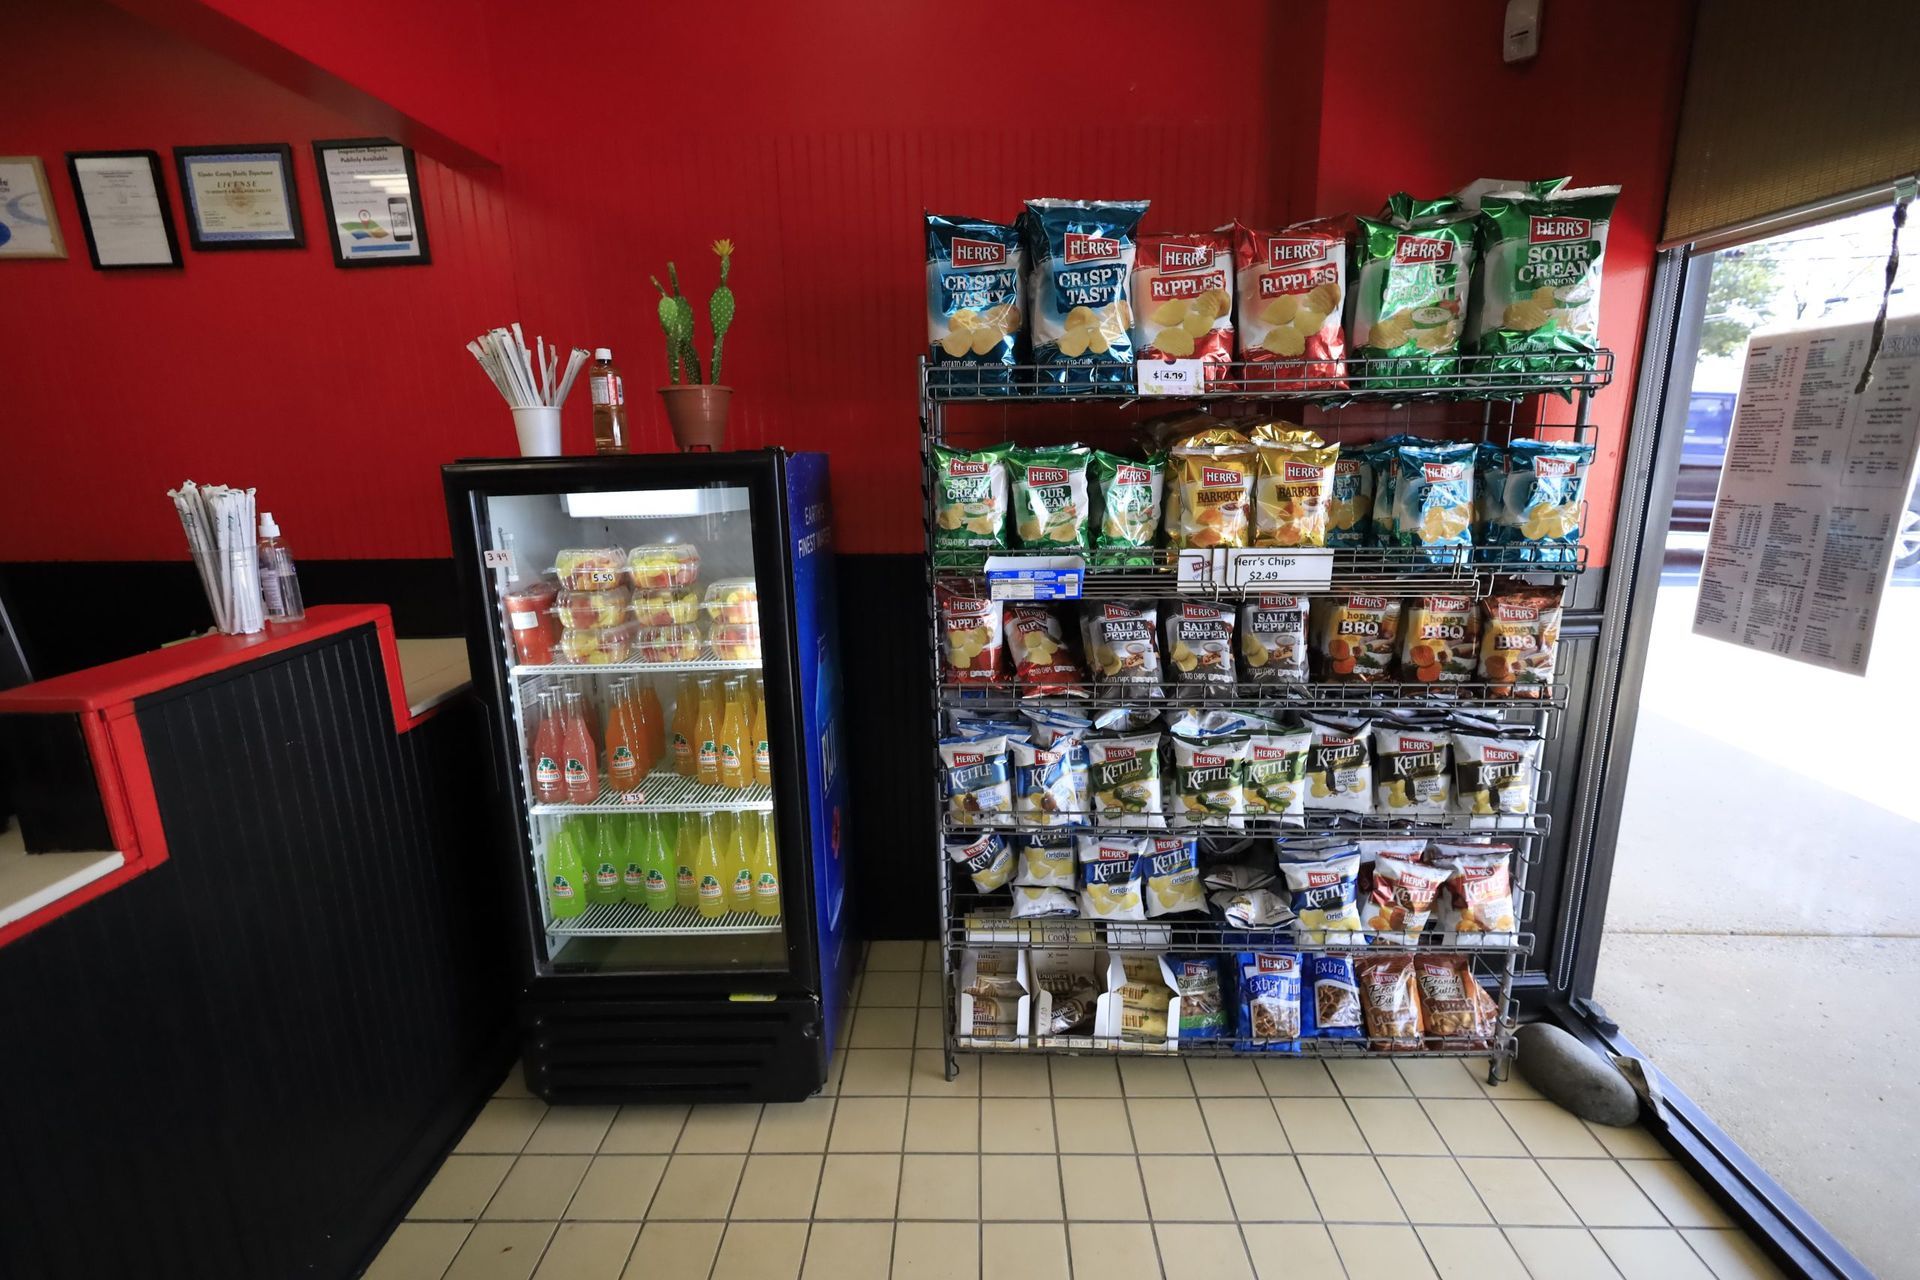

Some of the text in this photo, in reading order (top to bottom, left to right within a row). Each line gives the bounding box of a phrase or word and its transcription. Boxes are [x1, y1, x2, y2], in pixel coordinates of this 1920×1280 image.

[1536, 221, 1584, 237] HERR'S
[956, 245, 999, 261] HERR'S
[1070, 240, 1113, 257] HERR'S
[1274, 241, 1319, 261] HERR'S
[1401, 240, 1446, 259] HERR'S
[1528, 246, 1588, 264] SOUR
[1165, 249, 1208, 266] HERR'S
[945, 275, 995, 290] CRISP
[1058, 269, 1112, 288] CRISP
[1153, 274, 1224, 297] RIPPLES
[1262, 267, 1337, 294] RIPPLES
[952, 290, 1005, 307] TASTY
[953, 462, 985, 473] HERR'S
[1120, 468, 1147, 481] HERR'S
[1287, 466, 1321, 478] HERR'S
[1031, 471, 1064, 481] HERR'S
[1206, 471, 1238, 483] HERR'S
[1037, 487, 1066, 499] OUR
[1234, 556, 1296, 570] Herr's Chips
[1249, 571, 1278, 581] $2.49
[953, 601, 984, 611] HERR'S
[1263, 595, 1293, 606] HERR'S
[1186, 607, 1216, 617] HERR'S
[1257, 613, 1298, 623] SALT &
[1346, 611, 1380, 622] honey
[1502, 608, 1534, 619] HERR'S
[1105, 621, 1144, 632] SALT &
[1183, 622, 1222, 632] SALT &
[1254, 622, 1301, 632] PEPPER
[1429, 615, 1465, 626] honey
[1104, 629, 1150, 641] PEPPER
[1180, 630, 1228, 640] PEPPER
[1341, 621, 1379, 635] BBQ
[1424, 625, 1464, 639] BBQ
[1498, 634, 1536, 648] BBQ
[1402, 740, 1430, 750] HERR'S
[956, 755, 981, 764] HERR'S
[1195, 756, 1222, 765] HERR'S
[1256, 749, 1282, 758] HERR'S
[1316, 745, 1360, 767] KETTLE
[1486, 750, 1514, 760] HERR'S
[1393, 752, 1441, 776] KETTLE
[951, 763, 993, 789] KETTLE
[1102, 758, 1143, 785] KETTLE
[1187, 767, 1231, 790] KETTLE
[1248, 760, 1292, 783] KETTLE
[1477, 762, 1525, 787] KETTLE
[967, 838, 999, 872] KETTLE
[1045, 851, 1071, 860] Original
[1152, 848, 1191, 874] KETTLE
[1094, 860, 1135, 882] KETTLE
[1310, 873, 1337, 885] HERR'S
[1305, 882, 1349, 908] KETTLE
[1315, 960, 1345, 975] Extra
[1249, 979, 1278, 993] Extra
